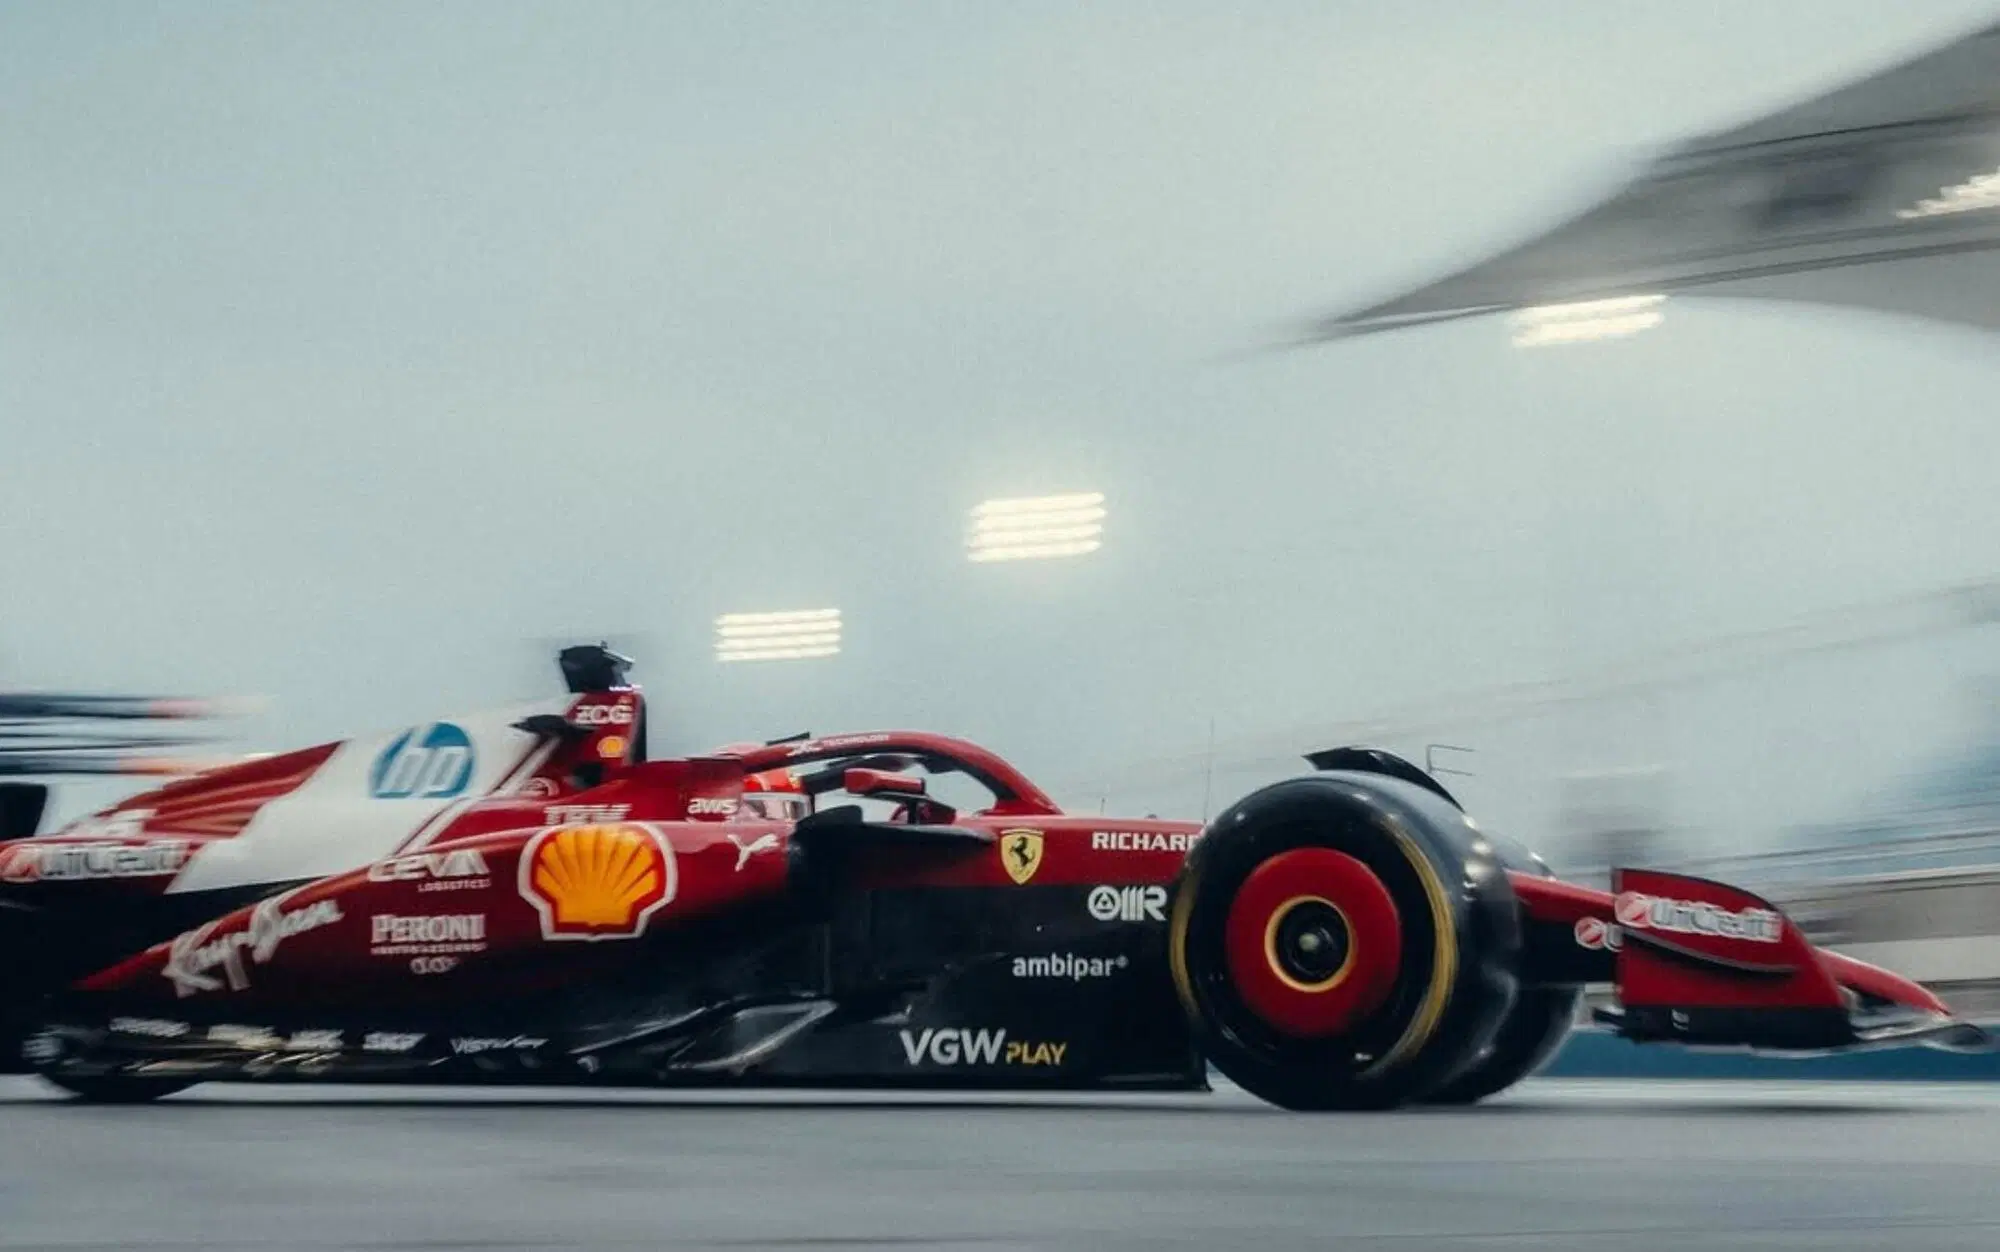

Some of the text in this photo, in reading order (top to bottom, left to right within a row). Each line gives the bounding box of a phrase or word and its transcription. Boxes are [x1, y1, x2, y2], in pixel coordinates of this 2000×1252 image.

[376, 722, 473, 800] hp
[687, 797, 738, 815] aws
[370, 914, 486, 943] PERONI
[900, 1028, 1067, 1066] VGW PLAY
